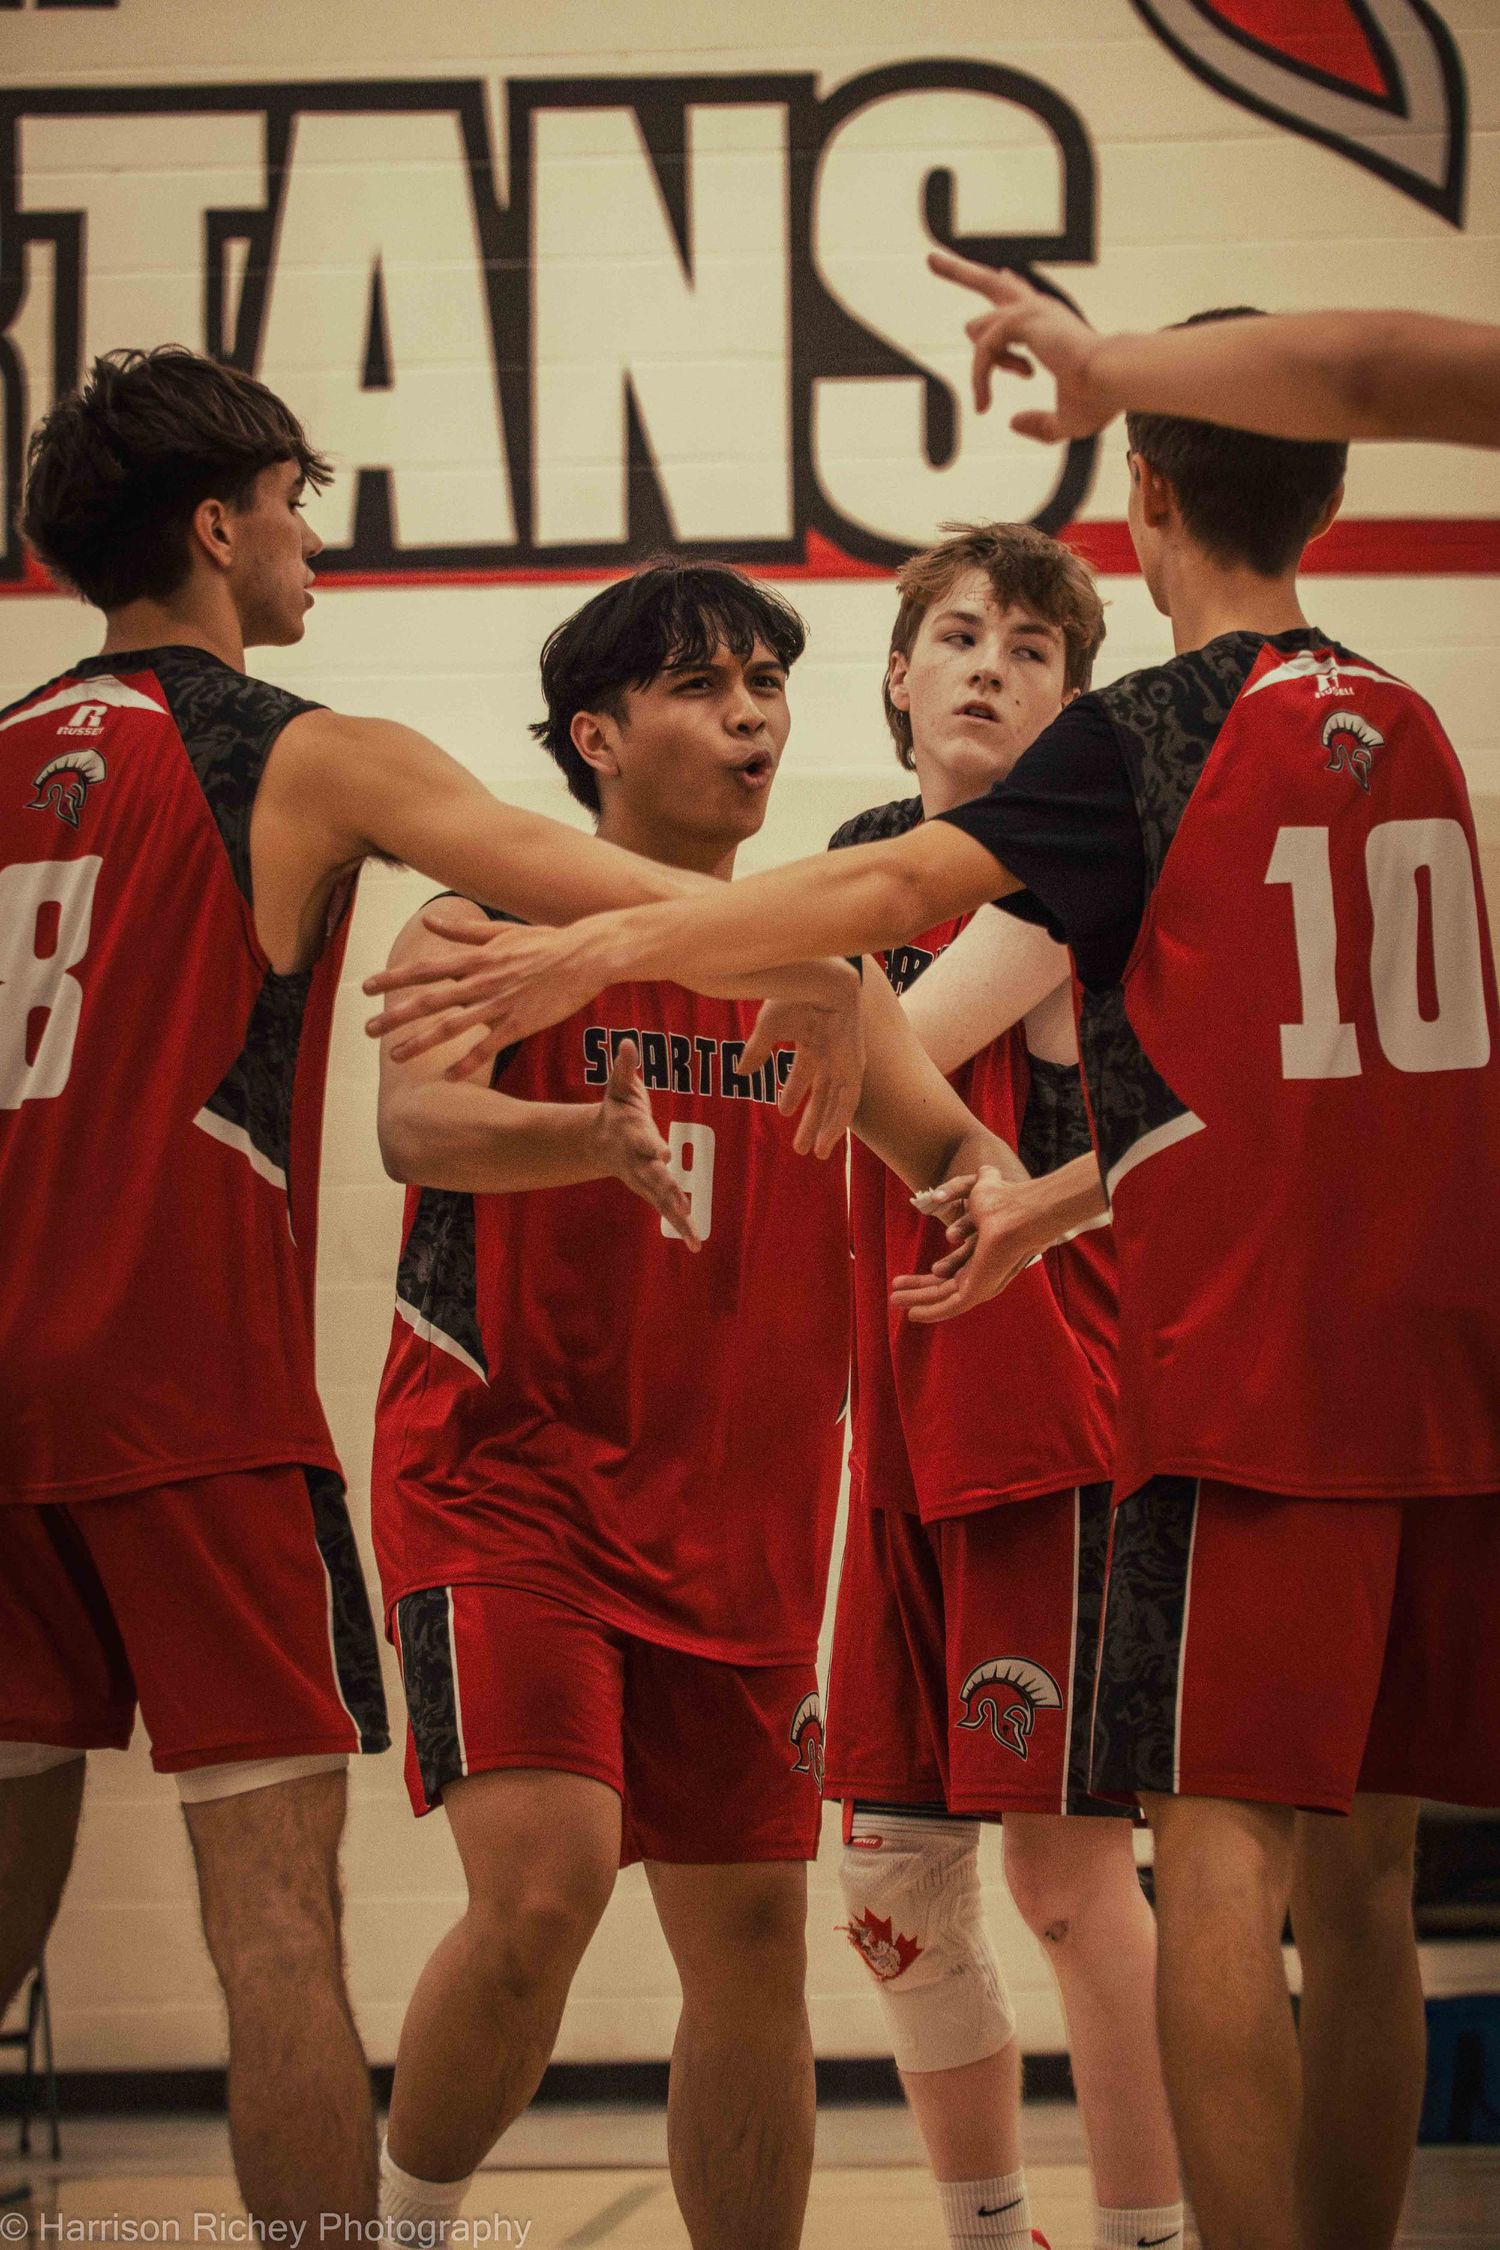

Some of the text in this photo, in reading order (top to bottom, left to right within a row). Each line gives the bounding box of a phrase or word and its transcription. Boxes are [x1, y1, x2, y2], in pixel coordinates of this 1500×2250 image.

[0, 57, 1098, 574] TANS
[0, 855, 103, 1110] 8
[1264, 818, 1491, 1080] 10
[660, 1121, 716, 1242] 9
